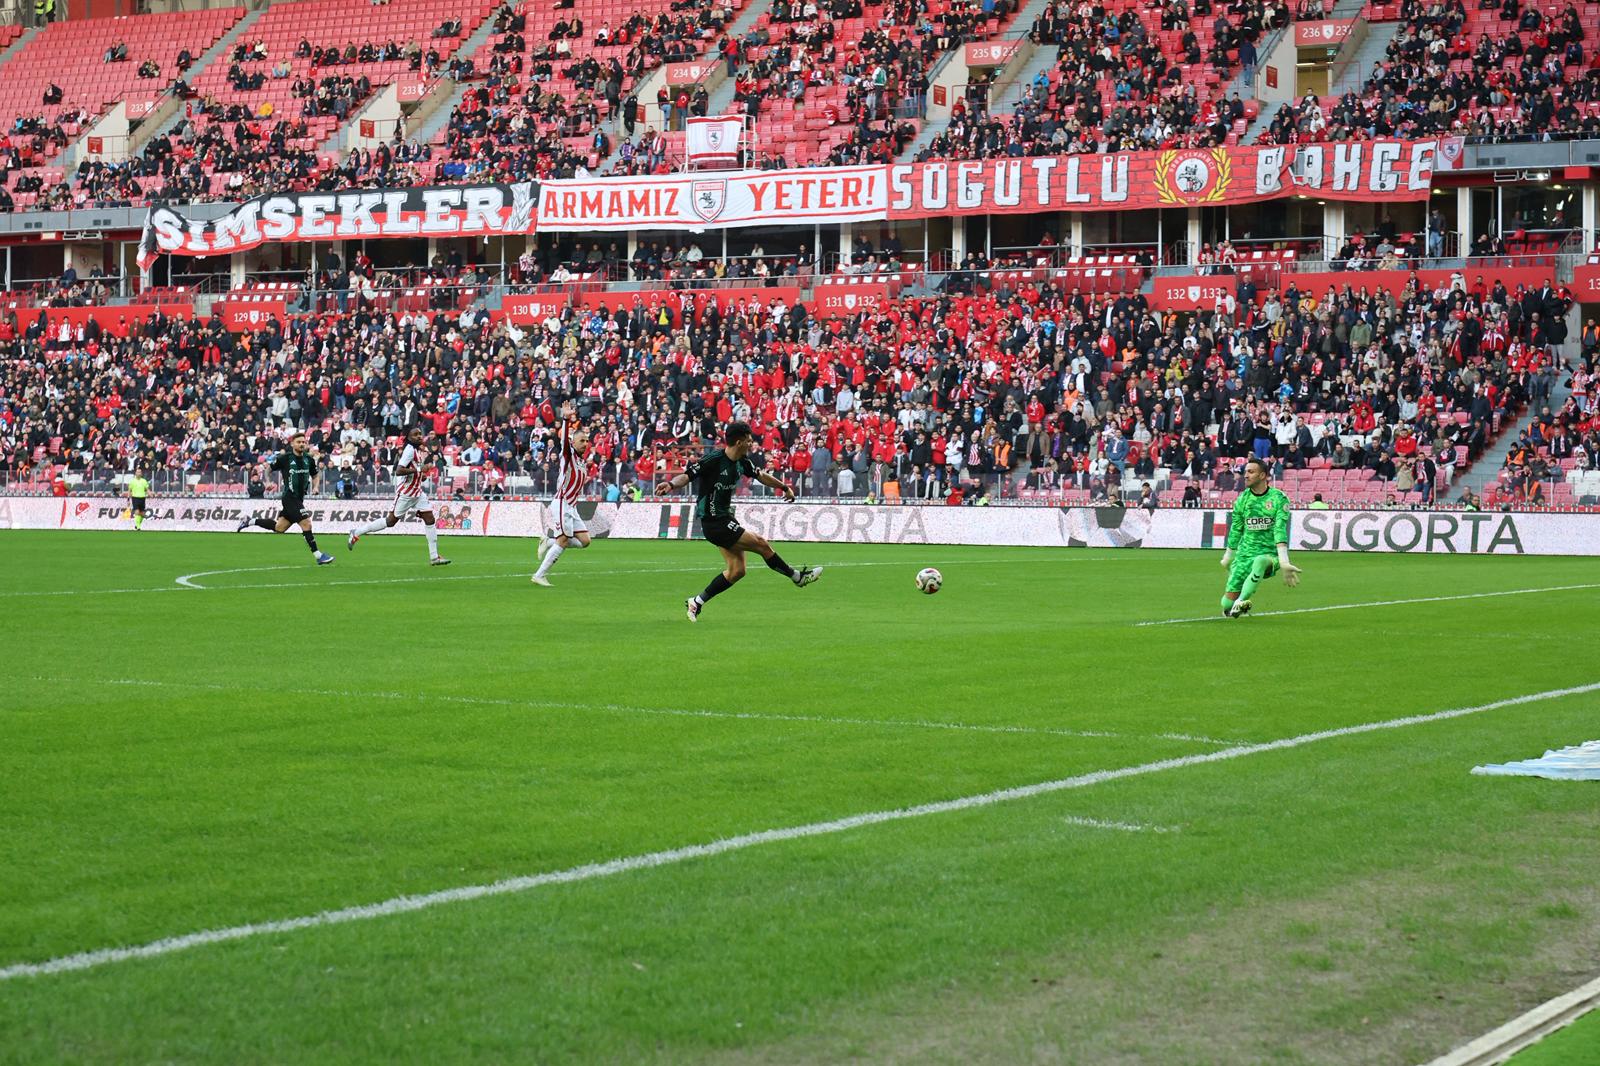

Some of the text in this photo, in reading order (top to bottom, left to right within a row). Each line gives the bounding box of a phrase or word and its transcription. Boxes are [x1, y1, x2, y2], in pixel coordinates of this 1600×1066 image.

[1302, 27, 1321, 38] 236
[972, 48, 989, 59] 235
[673, 68, 689, 78] 234
[402, 86, 417, 95] 233
[131, 103, 144, 113] 232
[543, 175, 876, 218] ARMAMIZ YETER!
[1167, 288, 1186, 300] 132
[825, 295, 875, 308] 131 132
[512, 305, 528, 316] 130
[234, 312, 249, 323] 129
[1246, 516, 1275, 526] COREX
